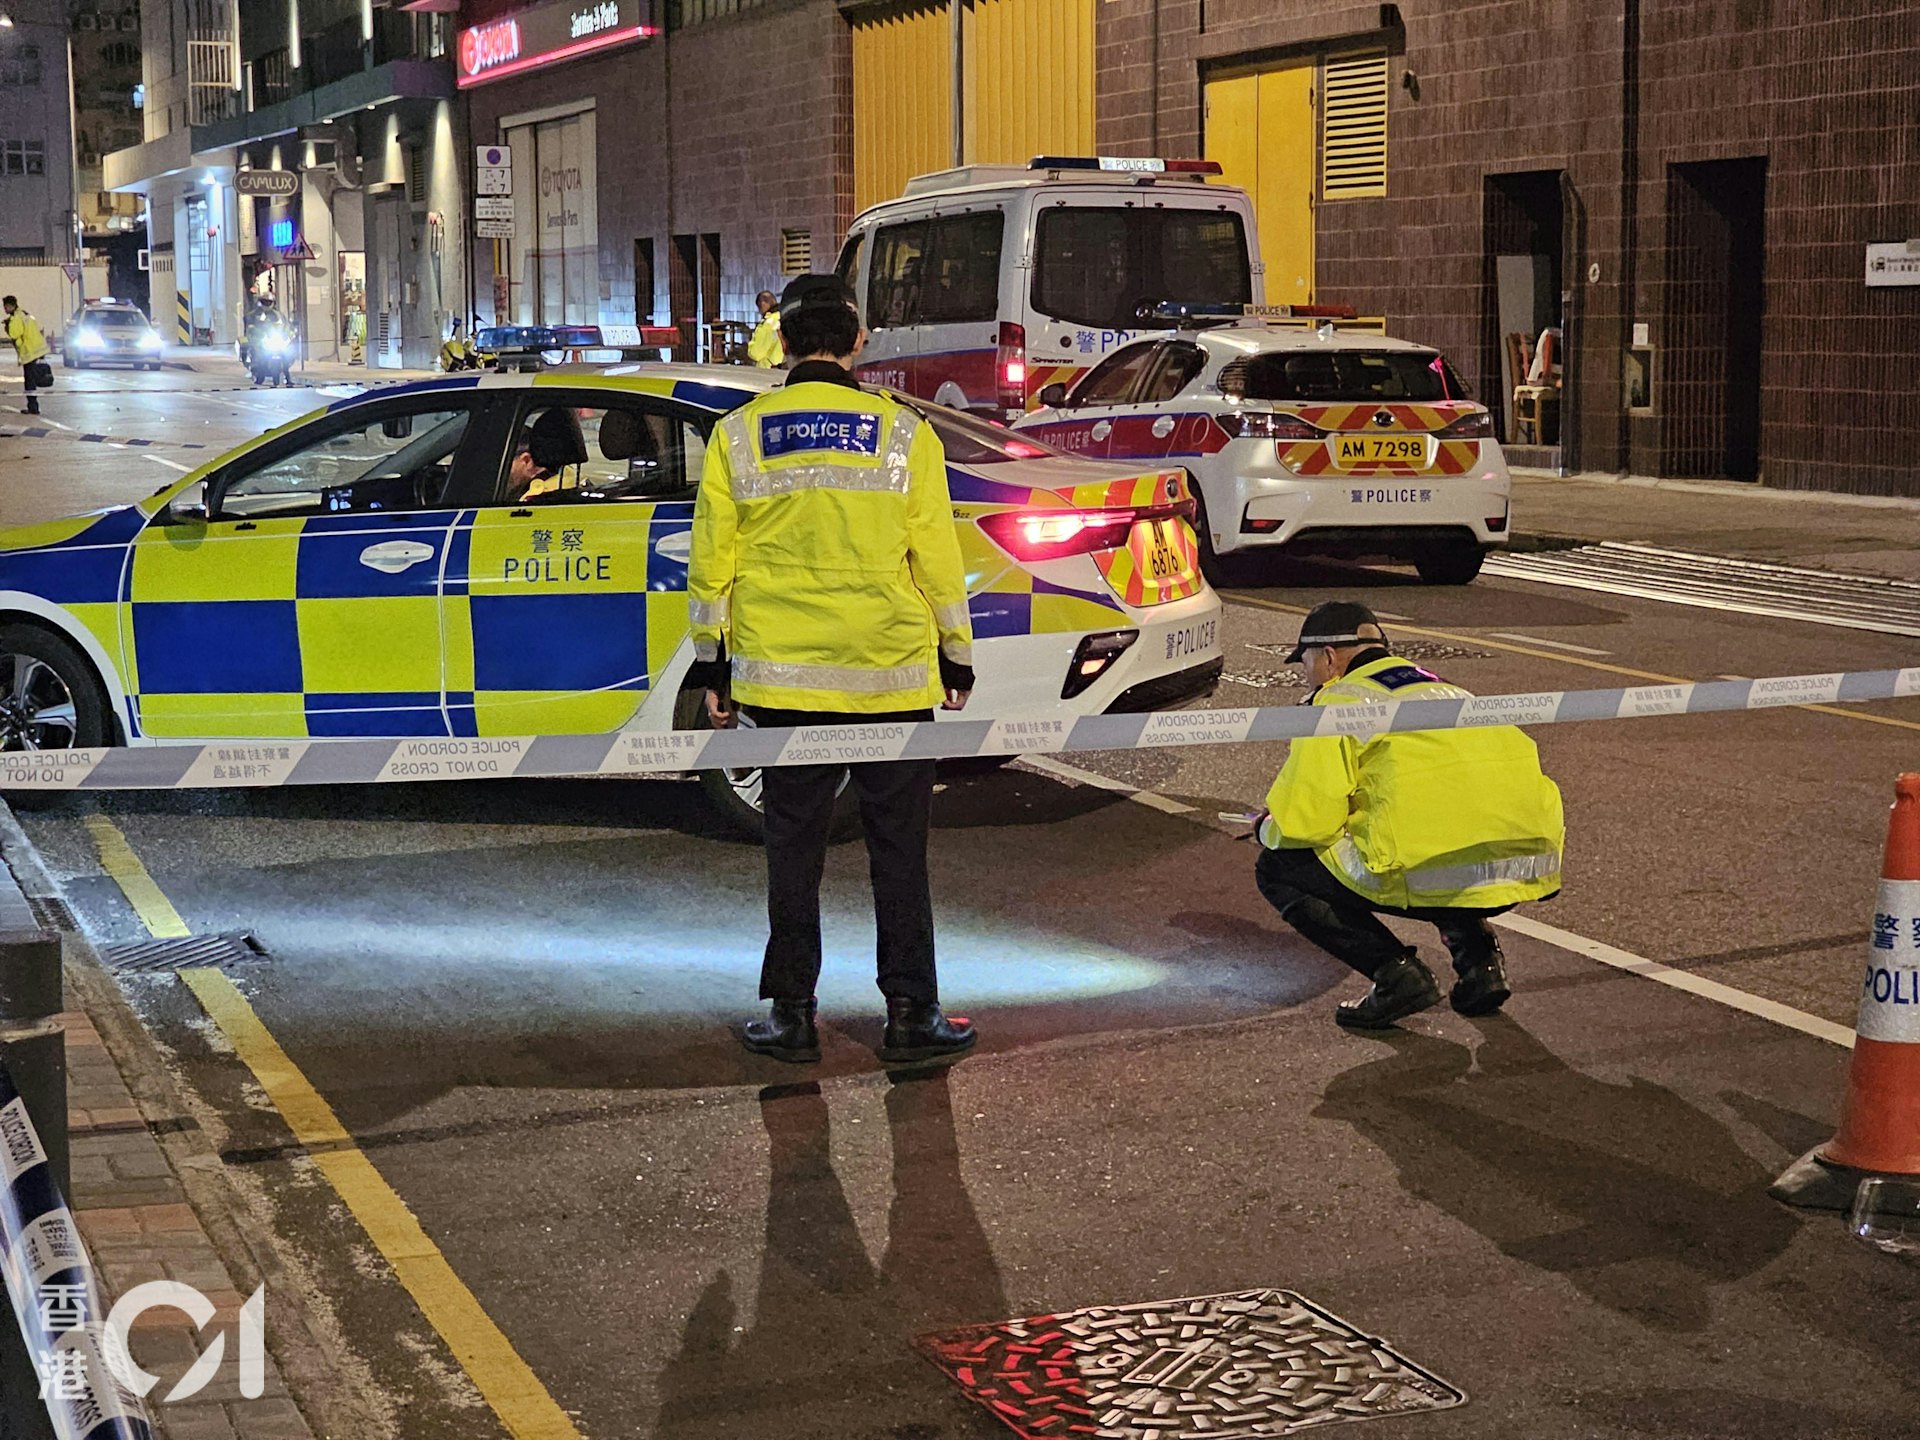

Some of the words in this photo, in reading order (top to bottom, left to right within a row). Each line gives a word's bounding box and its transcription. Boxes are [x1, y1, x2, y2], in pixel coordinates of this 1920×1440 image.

[500, 170, 505, 178] 7
[1116, 159, 1148, 171] POLICE
[240, 177, 292, 189] CAMLUX
[500, 184, 505, 192] 7
[552, 168, 582, 192] TOYOTA
[1255, 306, 1279, 315] POLICE
[1076, 330, 1096, 353] 警
[786, 422, 851, 440] POLICE
[1051, 431, 1081, 450] POLICE
[1342, 441, 1365, 457] AM
[1373, 441, 1422, 457] 7298
[1367, 489, 1417, 502] POLICE
[531, 529, 584, 553] 警察
[1151, 520, 1167, 549] AM
[505, 555, 611, 582] POLICE
[1152, 547, 1178, 576] 6876
[1176, 622, 1210, 657] POLICE
